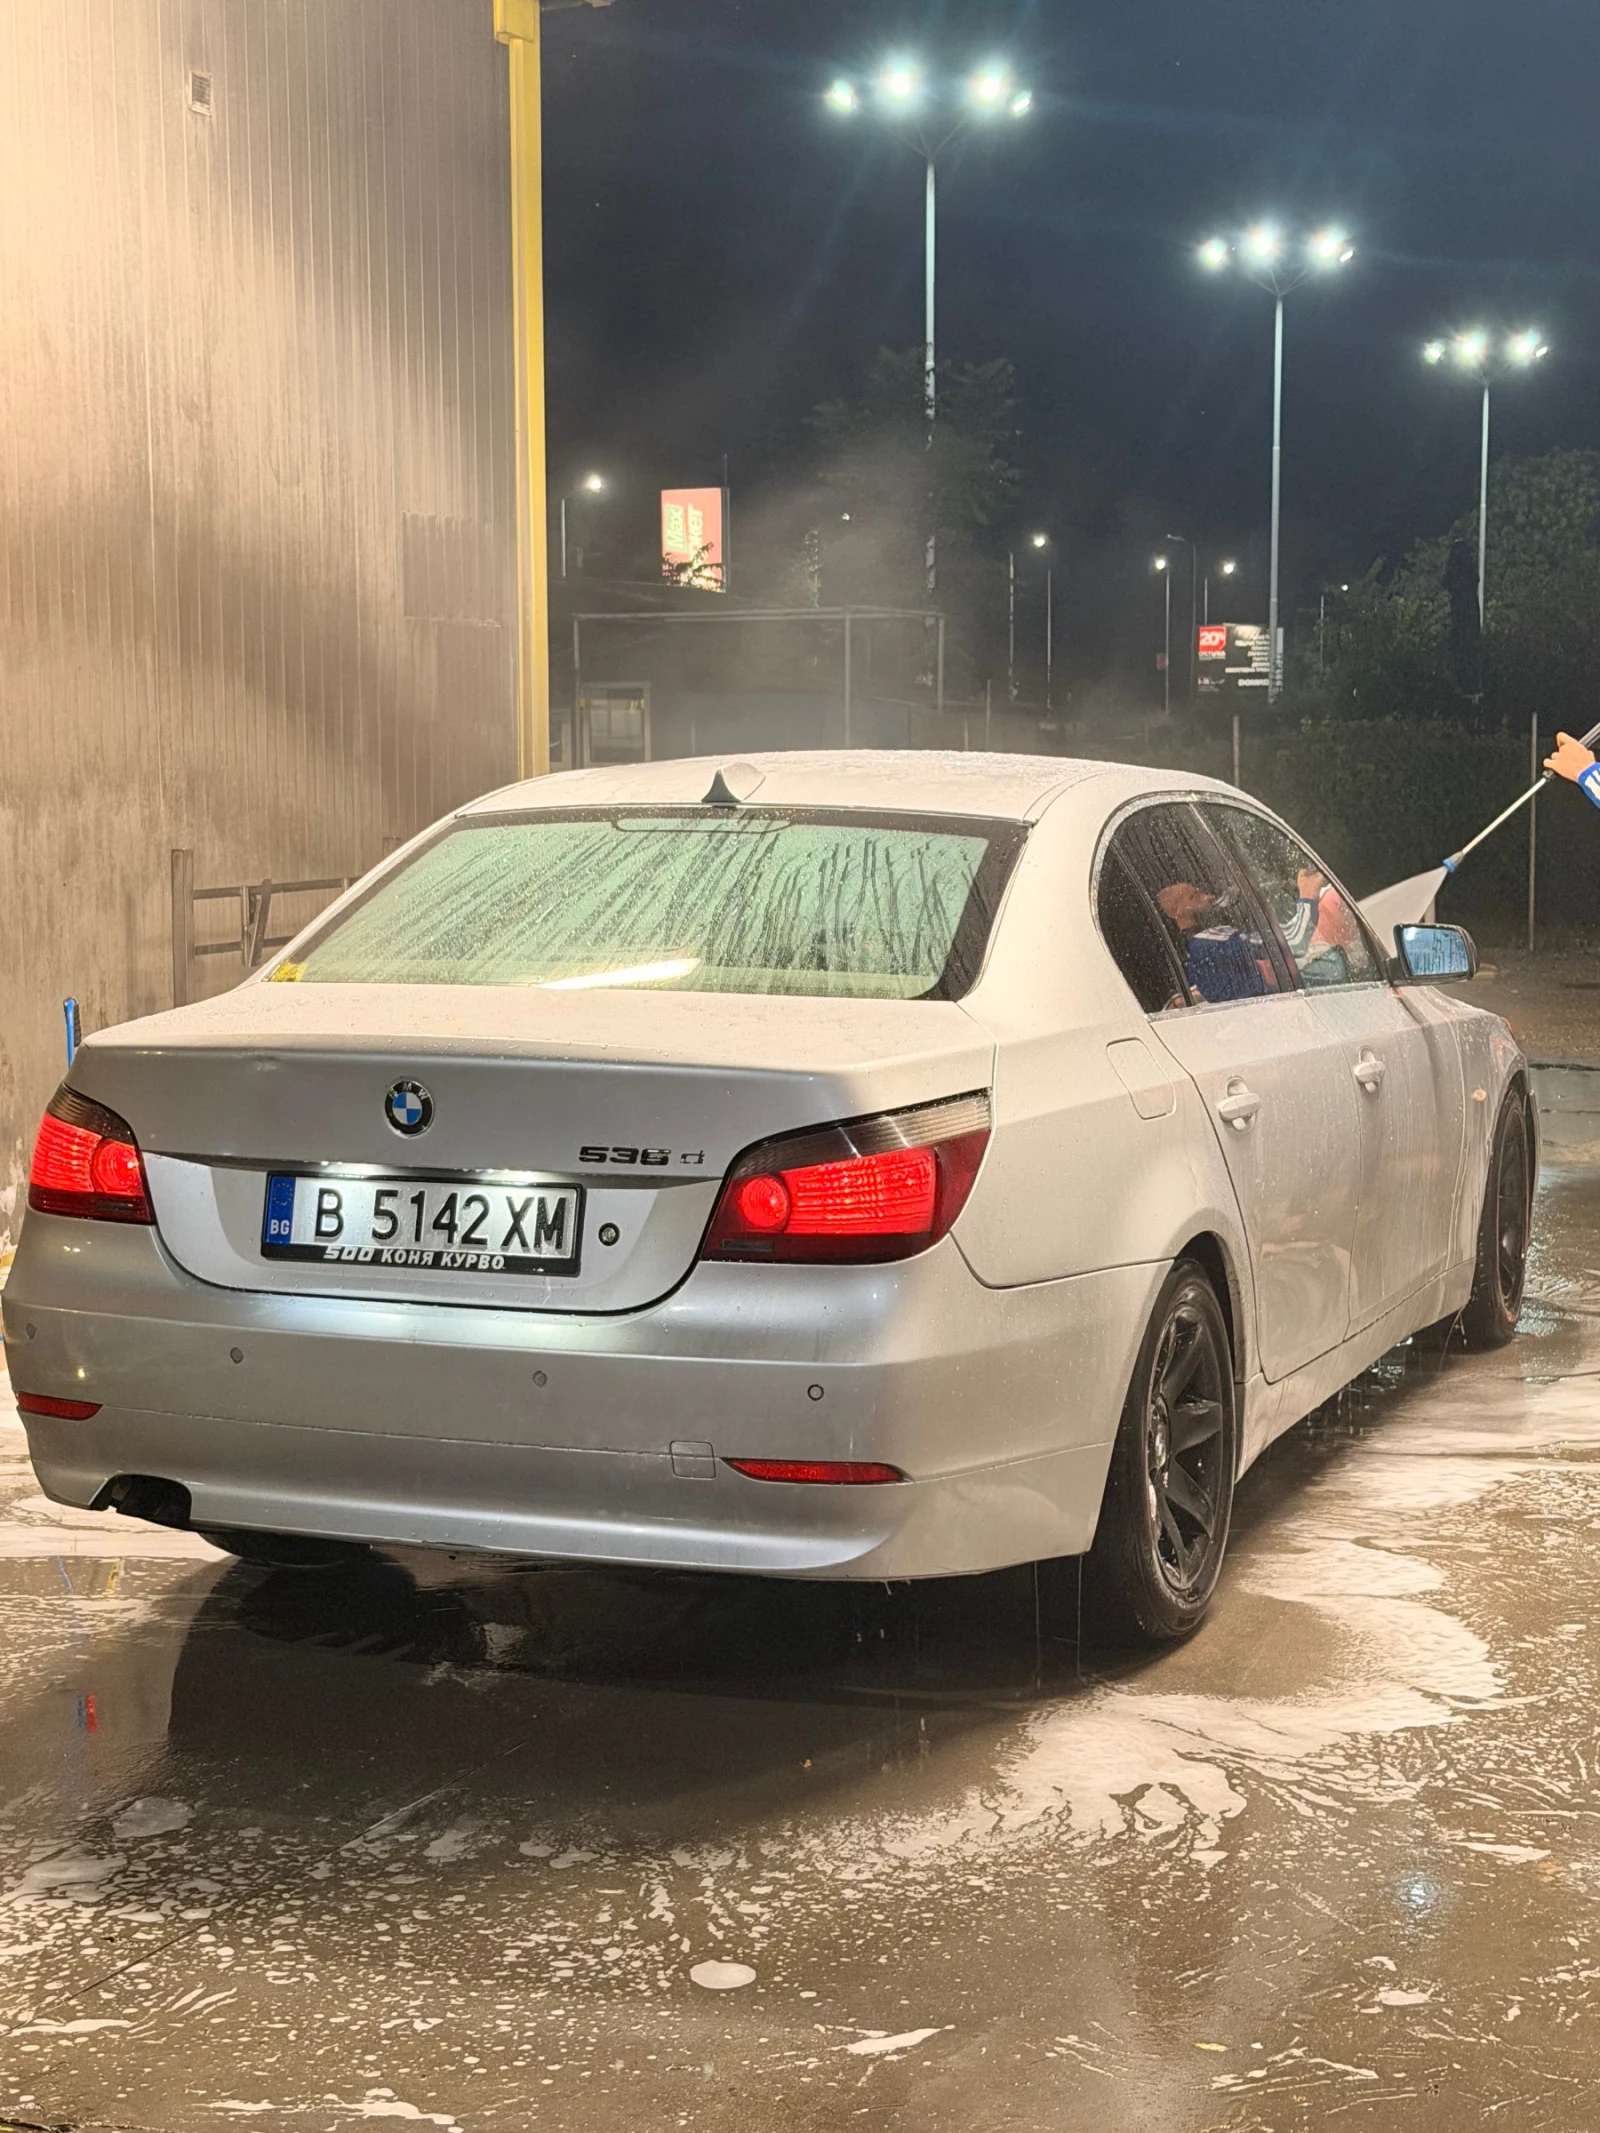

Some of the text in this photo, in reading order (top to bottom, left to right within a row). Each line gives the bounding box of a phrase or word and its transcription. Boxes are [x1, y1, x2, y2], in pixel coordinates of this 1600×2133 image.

[270, 1219, 290, 1236] BG
[372, 1190, 489, 1246] 5142
[381, 1249, 434, 1266] КОНЯ
[440, 1252, 505, 1270] КУРВО
